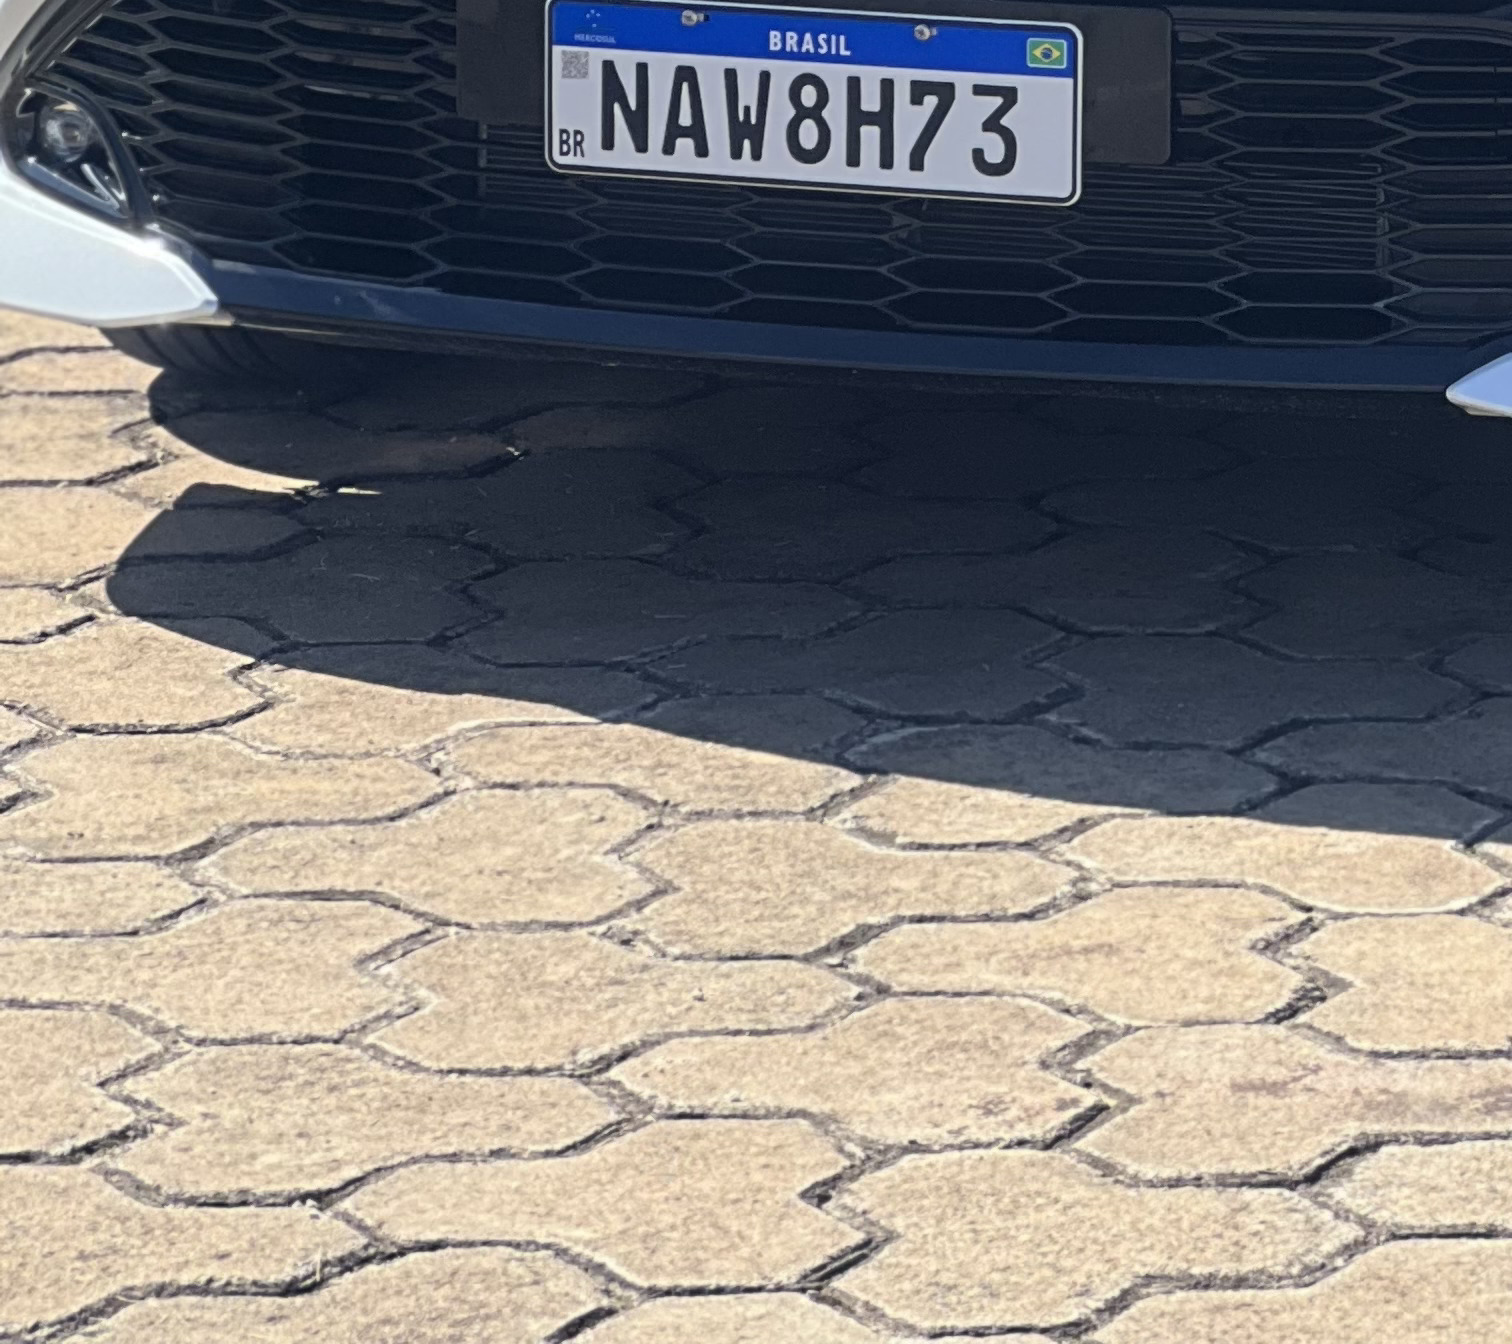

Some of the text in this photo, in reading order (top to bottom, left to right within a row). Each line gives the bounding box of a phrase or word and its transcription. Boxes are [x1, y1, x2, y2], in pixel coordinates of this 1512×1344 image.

[768, 30, 851, 57] BRASIL
[600, 59, 1019, 177] NAW8H73
[558, 128, 585, 158] BR
